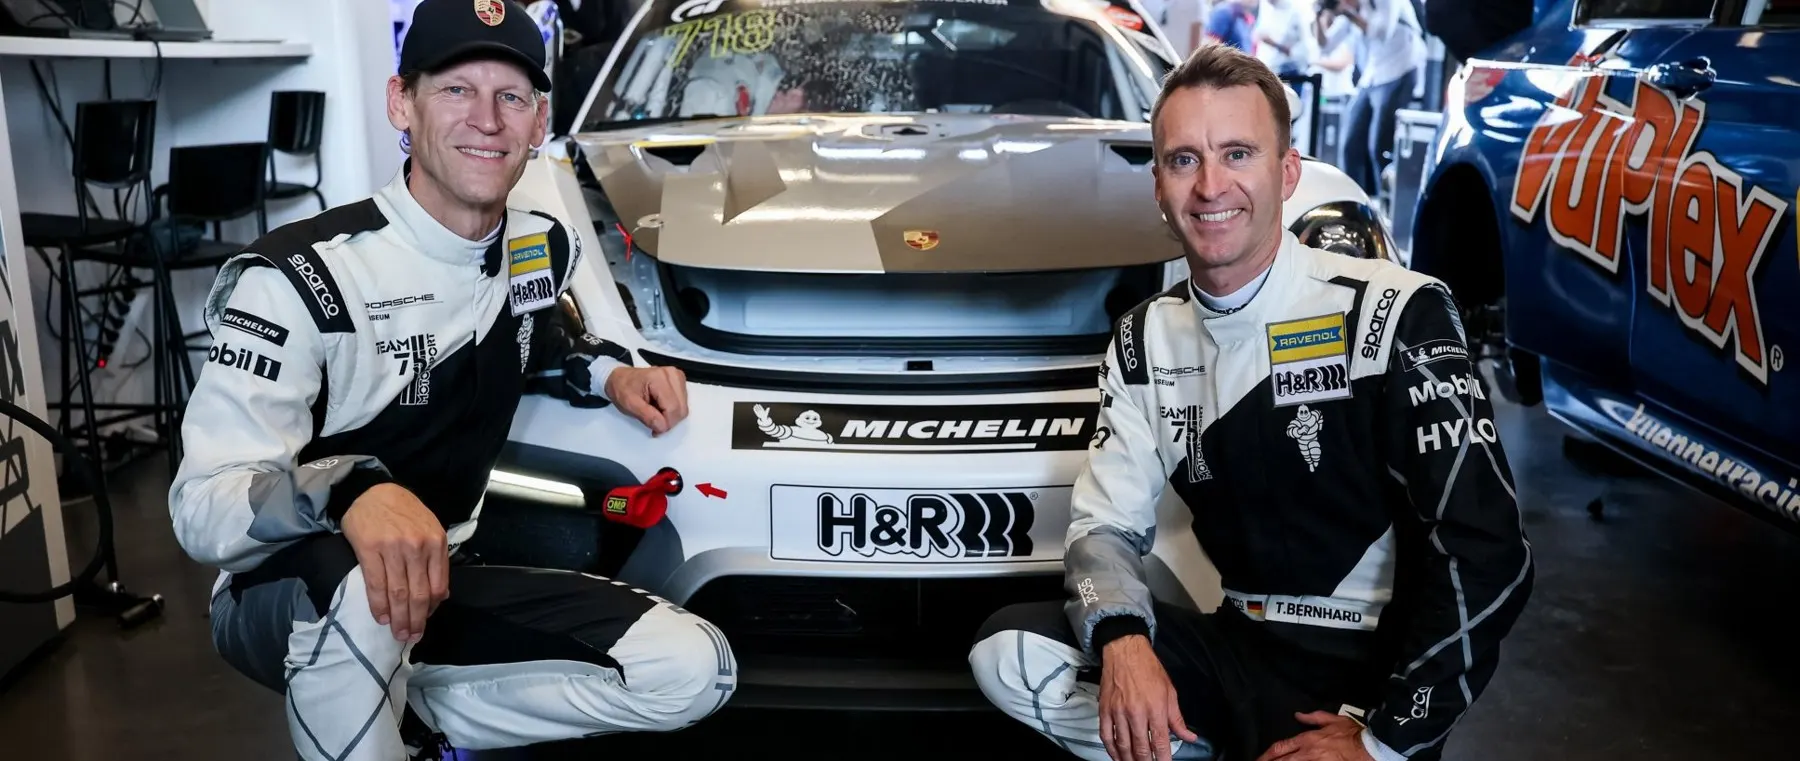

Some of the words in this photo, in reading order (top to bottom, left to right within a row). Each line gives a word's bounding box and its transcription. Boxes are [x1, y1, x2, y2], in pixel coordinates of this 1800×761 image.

[663, 9, 778, 69] 718
[289, 253, 340, 318] sparco
[365, 293, 435, 309] PORSCHE
[223, 313, 280, 338] MICHELIN
[369, 313, 391, 321] SEUM
[1361, 288, 1396, 360] sparco
[376, 338, 410, 355] TEAM
[1122, 314, 1138, 370] sparco
[1280, 331, 1337, 347] RAVENOL
[208, 342, 253, 372] obil
[1152, 365, 1206, 376] PORSCHE
[1155, 378, 1175, 387] SEUM
[1160, 406, 1187, 419] EAM
[839, 417, 1086, 438] MICHELIN
[1416, 418, 1497, 454] HYLO
[606, 499, 627, 510] OMP
[1275, 601, 1362, 623] T.BERNHARD
